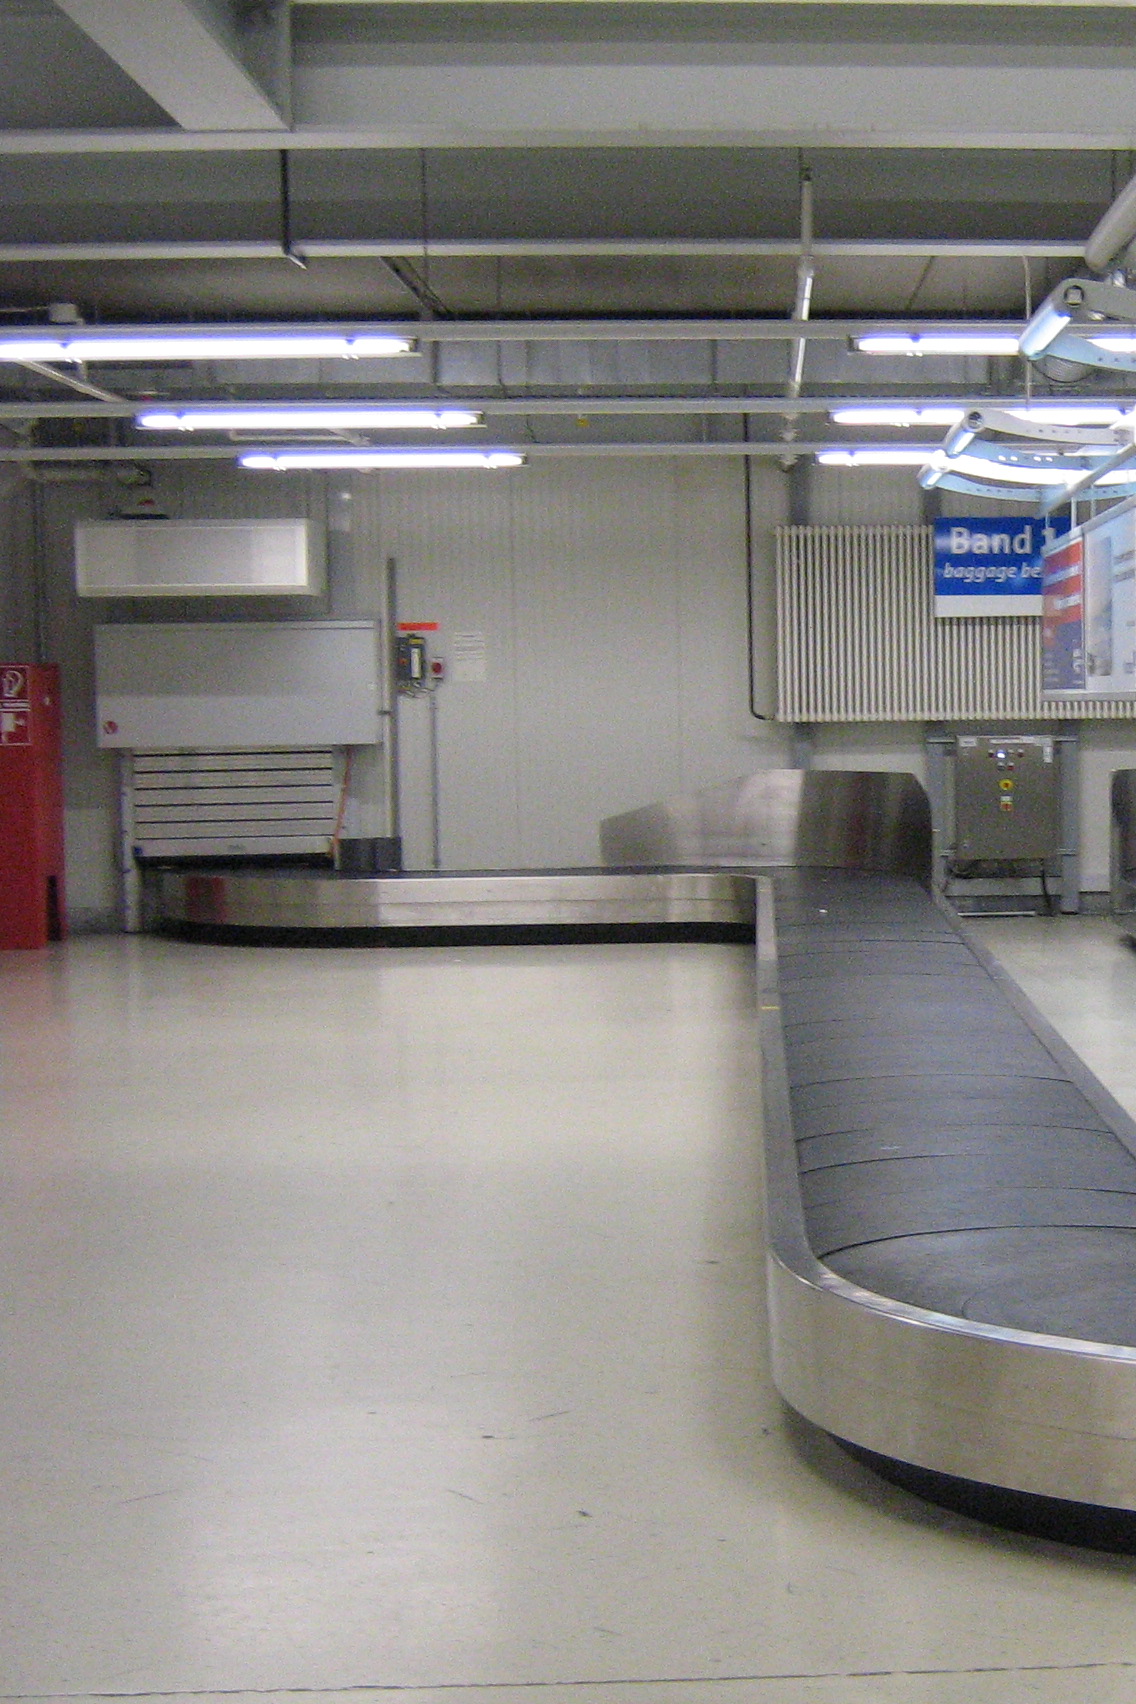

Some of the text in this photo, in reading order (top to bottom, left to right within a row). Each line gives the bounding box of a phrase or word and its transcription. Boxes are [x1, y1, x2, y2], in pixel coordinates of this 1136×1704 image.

[950, 525, 1032, 554] Band
[943, 562, 1017, 583] baggage
[1021, 562, 1042, 578] be
